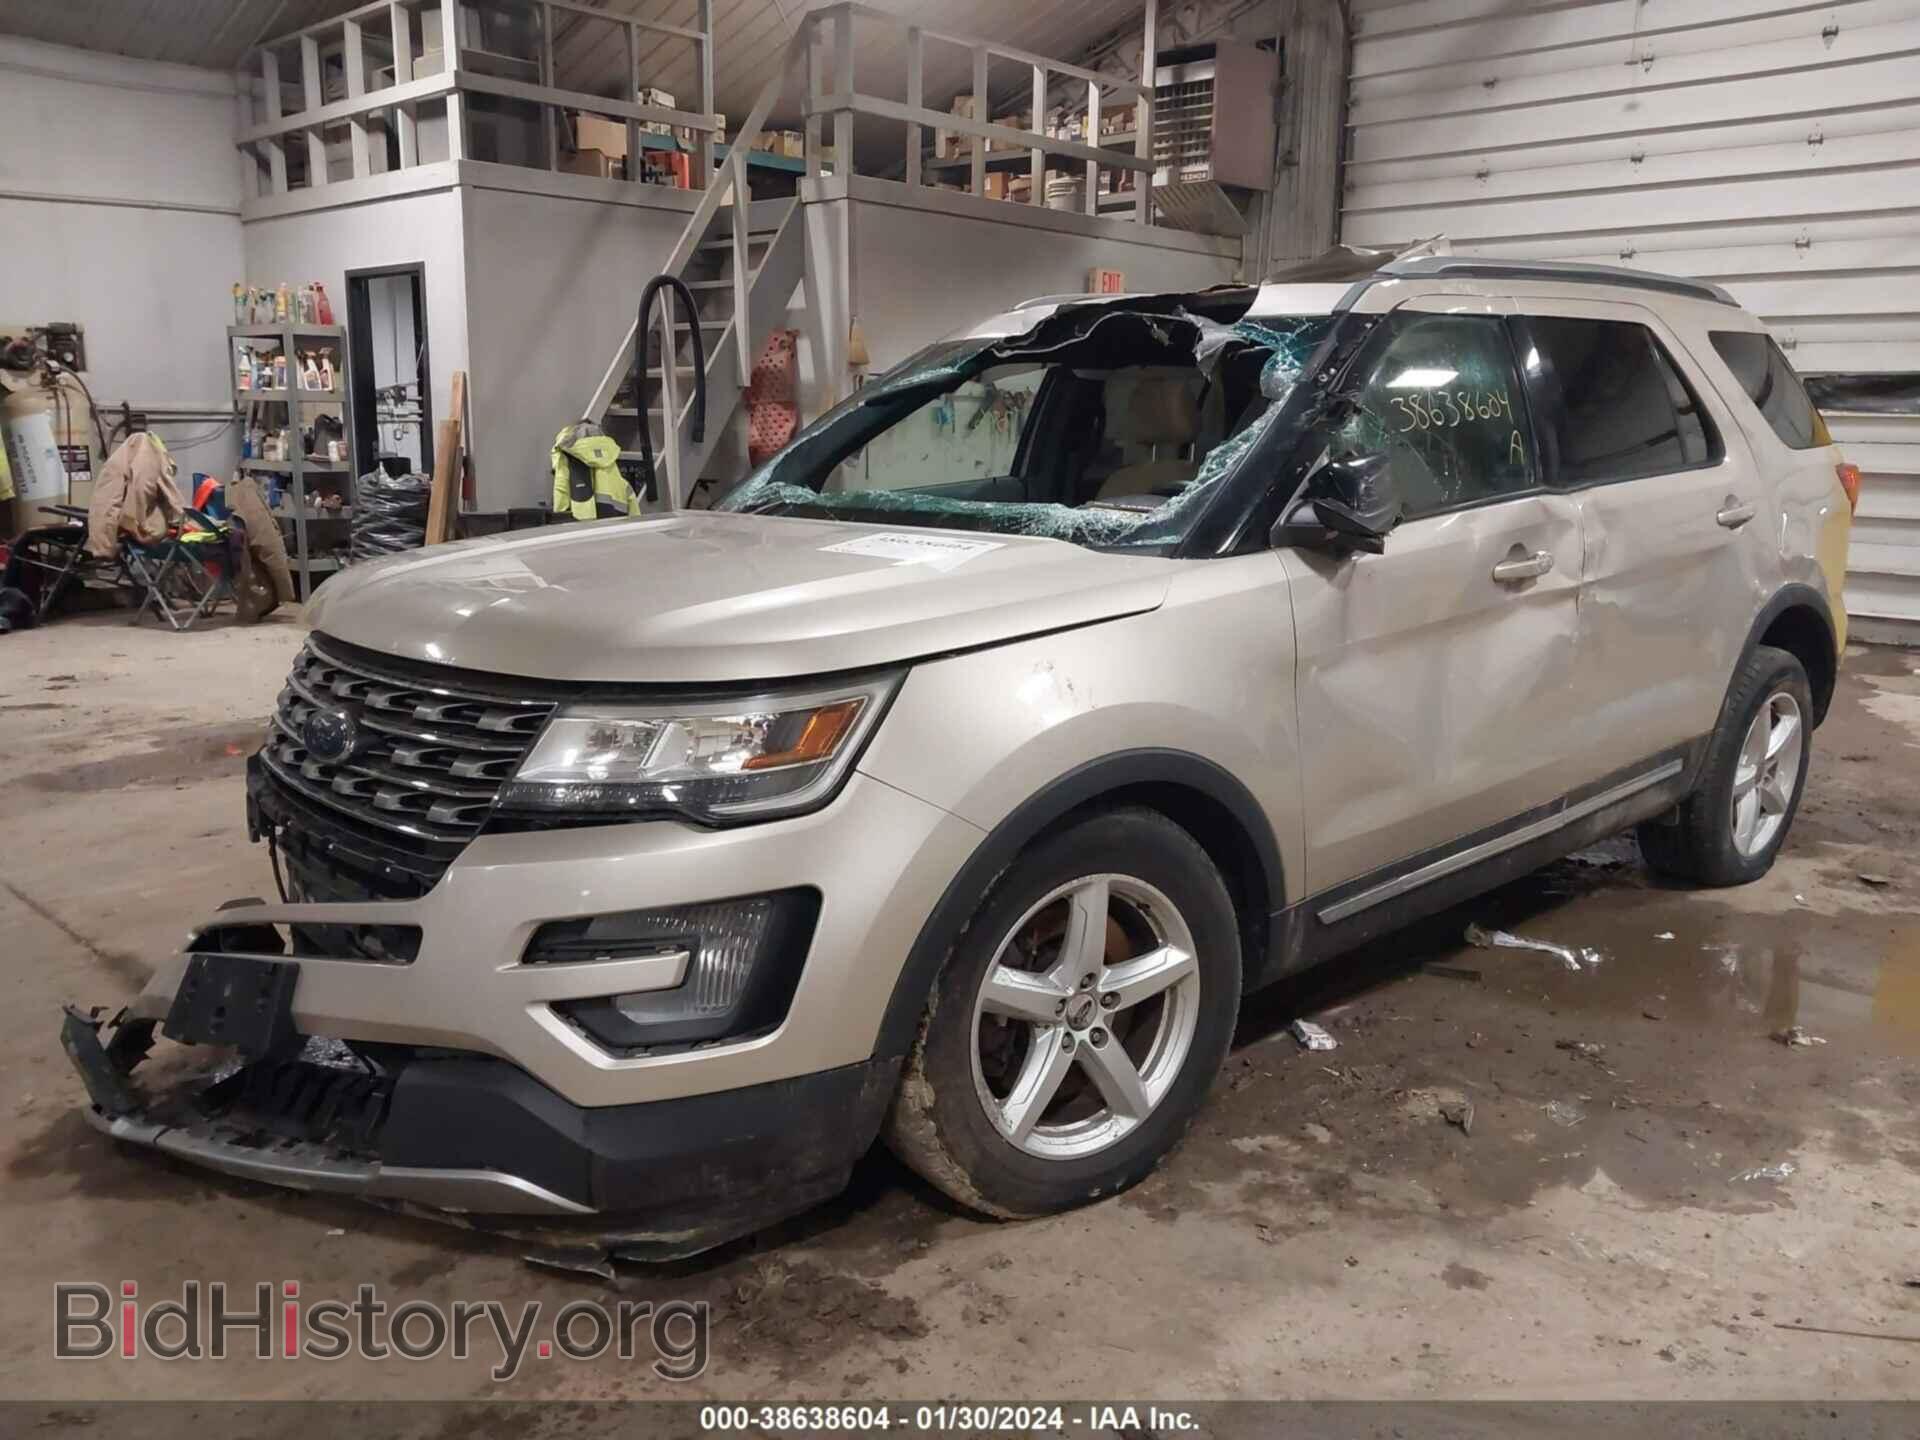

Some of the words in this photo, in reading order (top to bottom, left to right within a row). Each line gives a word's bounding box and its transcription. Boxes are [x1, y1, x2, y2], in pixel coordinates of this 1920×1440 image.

[1103, 271, 1121, 294] EXIT
[1391, 390, 1514, 432] 38638604
[1510, 430, 1525, 465] A
